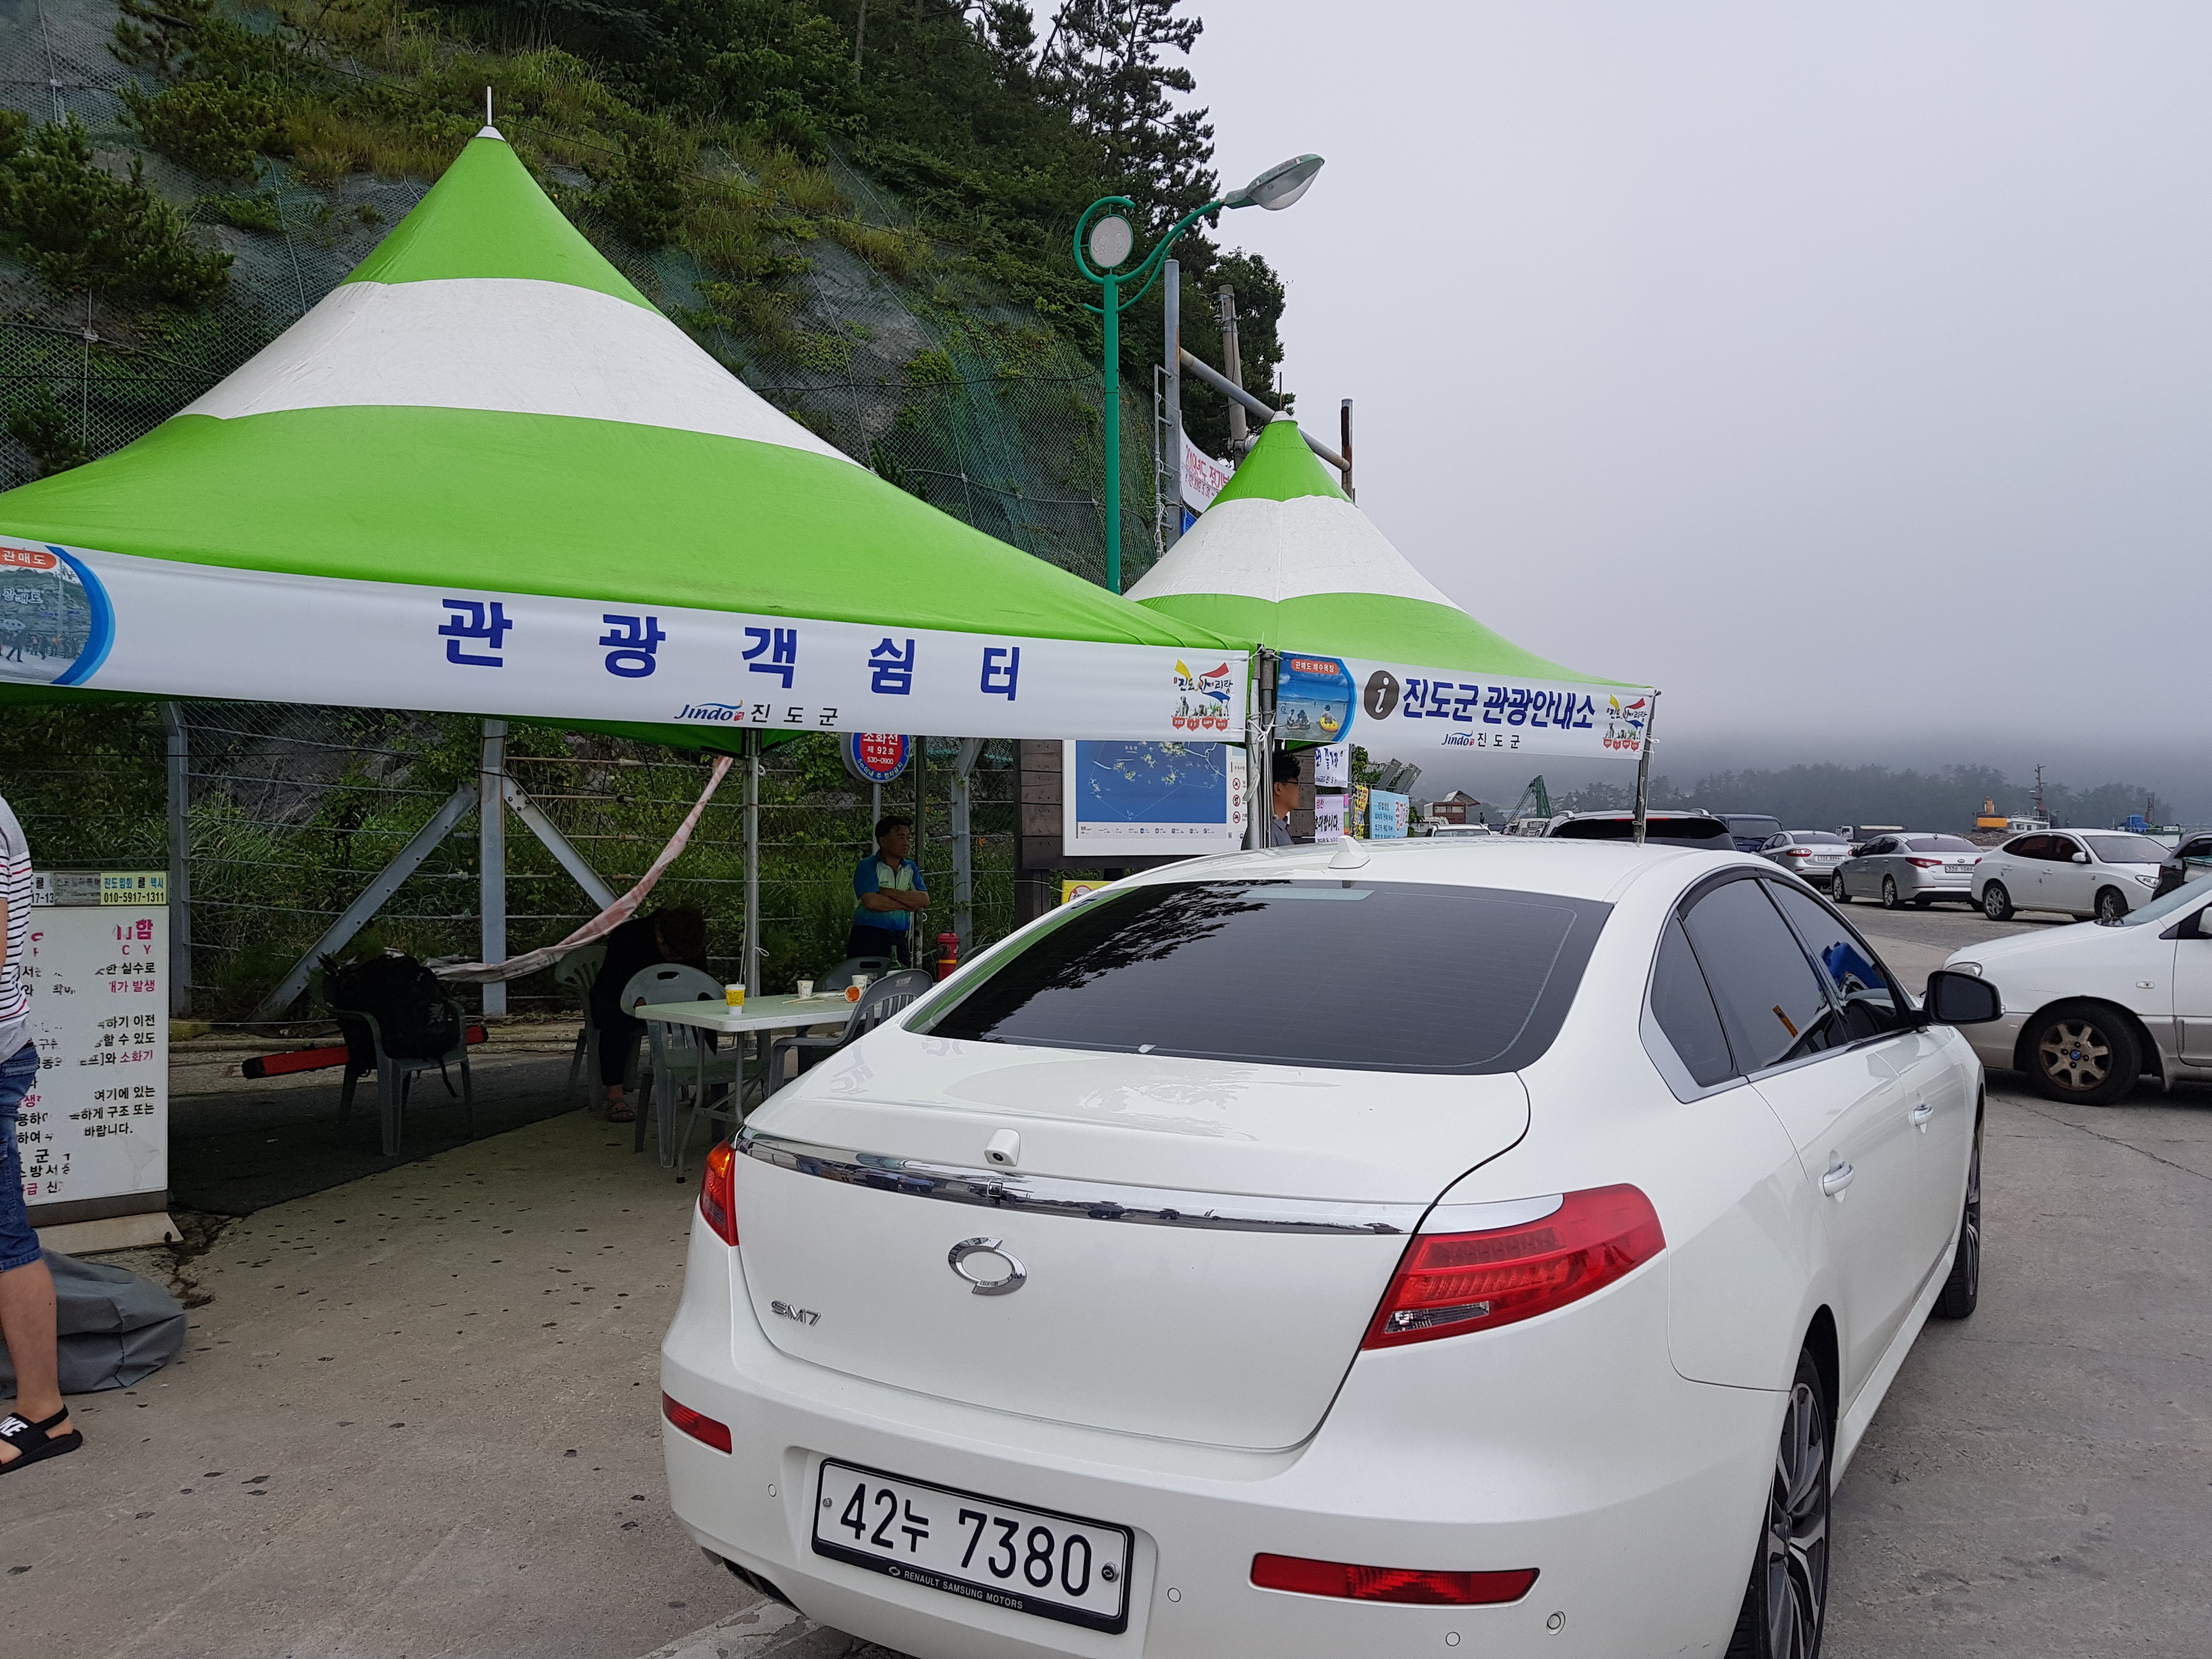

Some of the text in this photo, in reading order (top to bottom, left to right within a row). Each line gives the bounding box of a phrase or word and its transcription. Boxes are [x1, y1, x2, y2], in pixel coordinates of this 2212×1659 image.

[2, 550, 47, 565] 관매도
[1313, 663, 1334, 673] 해수욕장
[1402, 678, 1480, 722] 진도군
[1482, 686, 1596, 730] 관광안내소
[674, 704, 733, 721] Jindo
[863, 733, 898, 746] 소화전
[1441, 733, 1469, 746] Jindo
[867, 746, 874, 754] 제
[867, 757, 894, 765] 530-0900
[104, 891, 164, 903] 010-5917-1311
[121, 962, 156, 974] 실수로
[132, 979, 156, 992] 발생
[133, 1014, 156, 1026] 이전
[118, 1034, 130, 1045] 수
[134, 1032, 156, 1045] 있도
[120, 1049, 154, 1063] 소화기
[133, 1085, 156, 1099] 있는
[107, 1105, 130, 1119] 구조
[133, 1103, 155, 1116] 또는
[84, 1122, 133, 1138] 바랍니다.
[771, 1300, 822, 1327] SM7
[840, 1482, 1092, 1597] 42누 7380
[904, 1570, 1023, 1610] RENAULT SAMSUNG MOTORS
